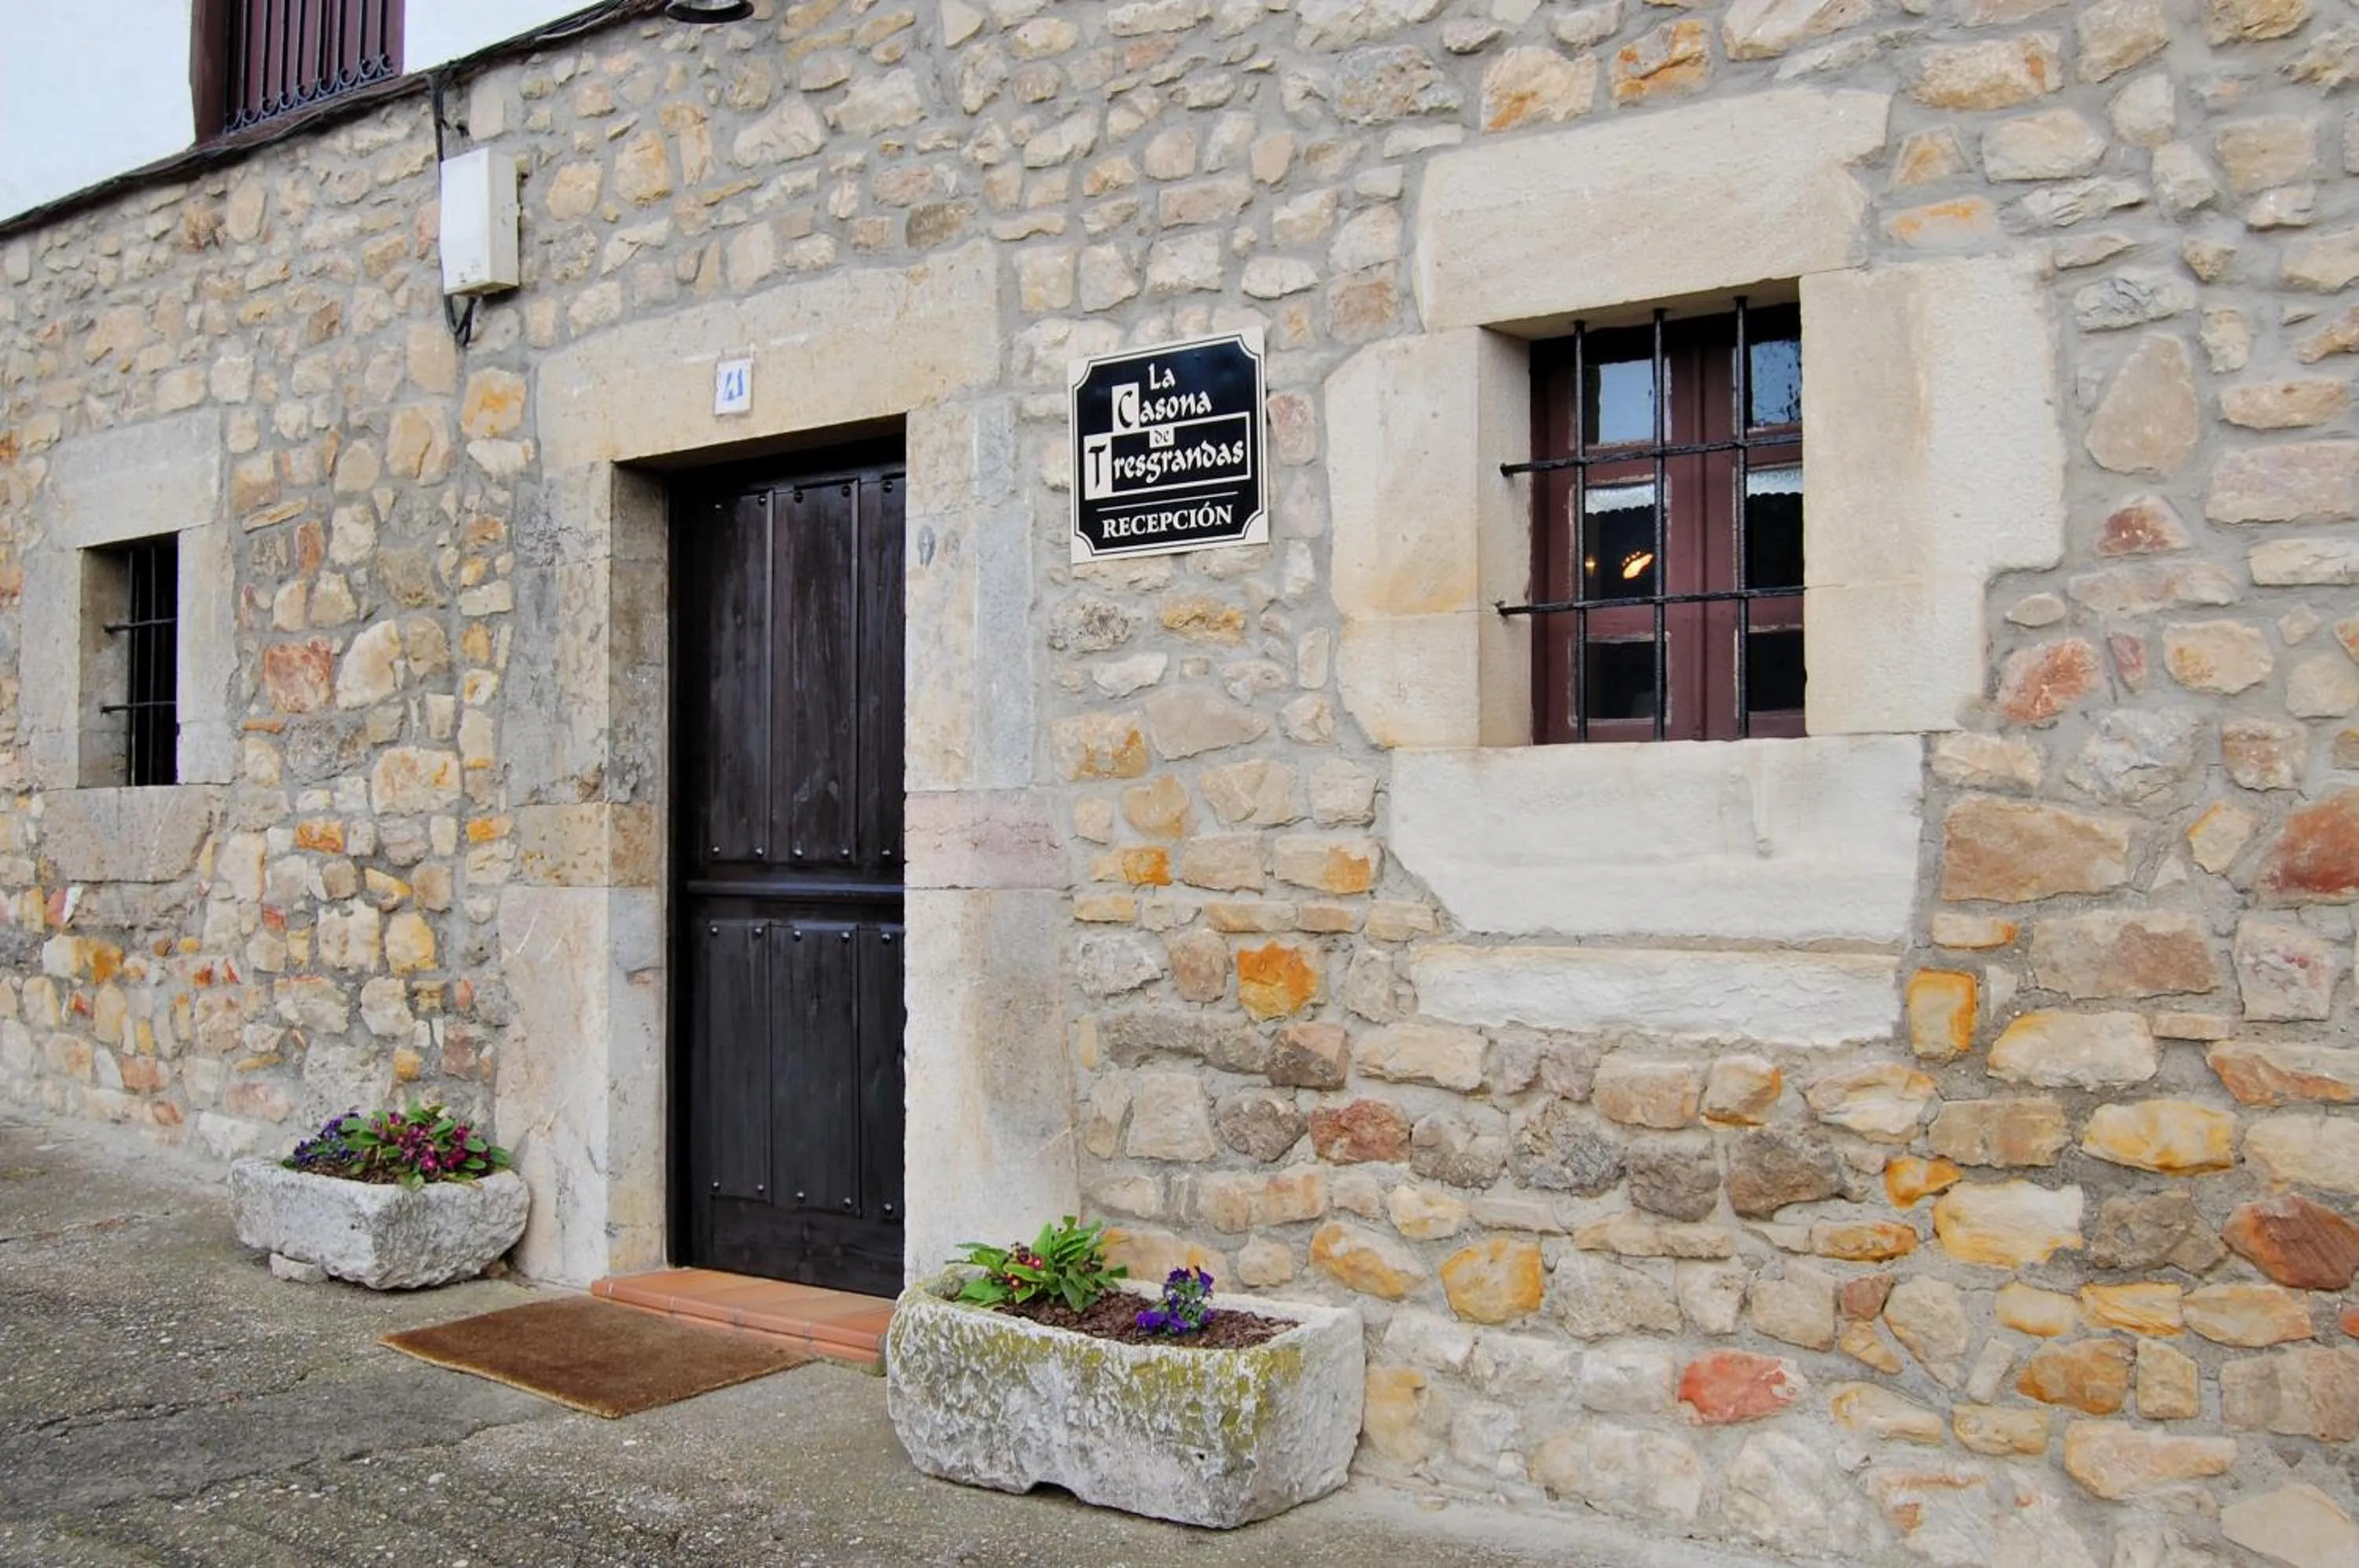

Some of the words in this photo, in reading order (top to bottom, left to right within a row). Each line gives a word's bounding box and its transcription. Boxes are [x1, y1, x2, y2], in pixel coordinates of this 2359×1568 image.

[1148, 363, 1176, 390] La
[1117, 390, 1213, 429] Casona
[1154, 429, 1170, 444] de
[1087, 440, 1245, 489] Tresgrandas
[1102, 501, 1234, 539] RECEPCIÓN
